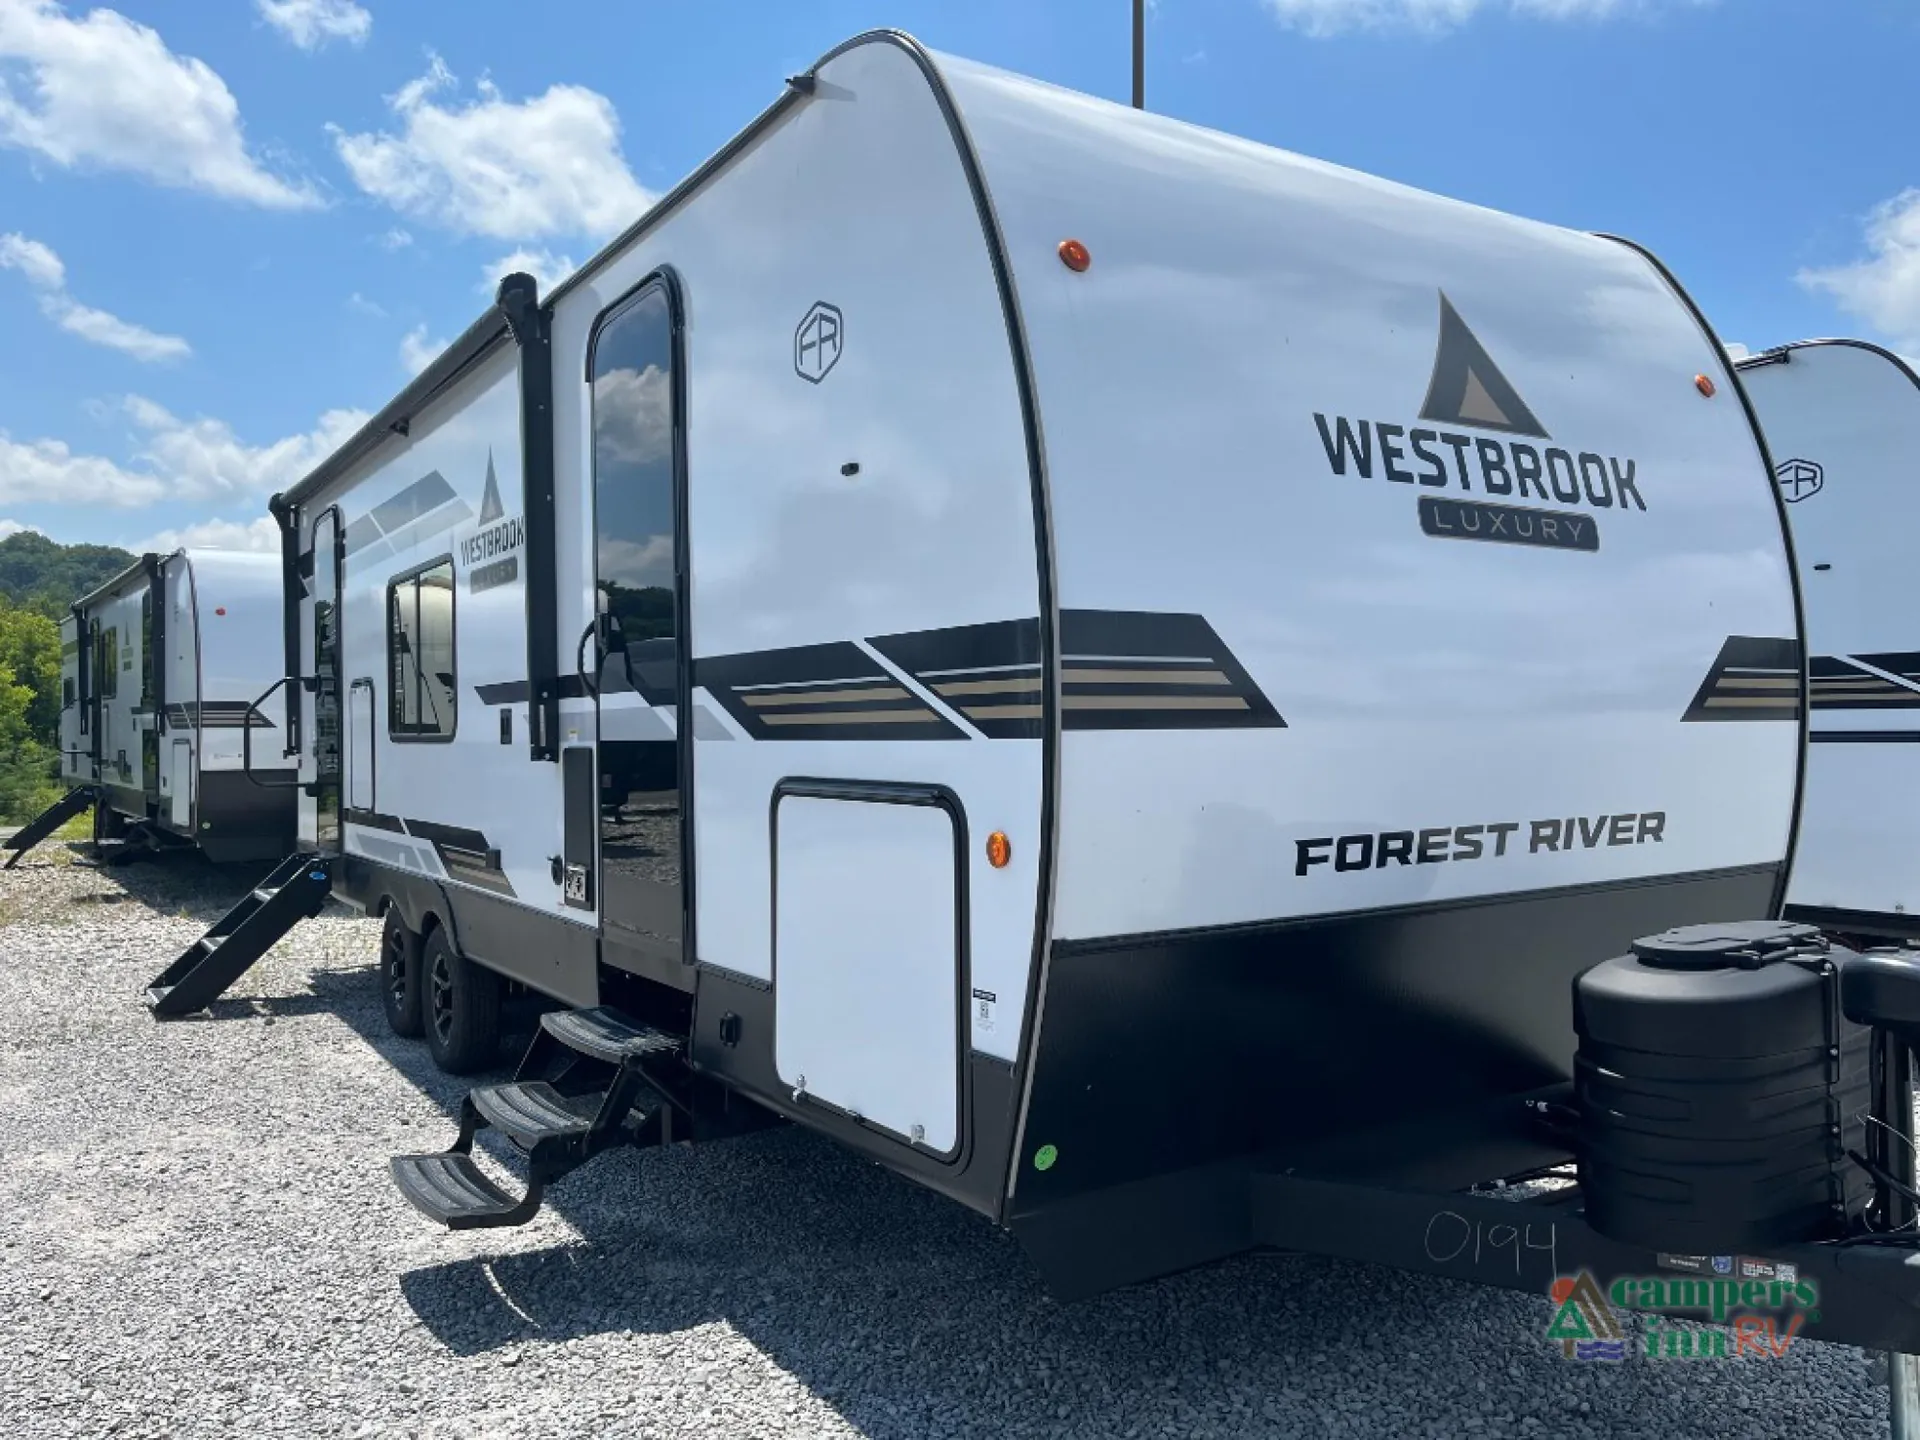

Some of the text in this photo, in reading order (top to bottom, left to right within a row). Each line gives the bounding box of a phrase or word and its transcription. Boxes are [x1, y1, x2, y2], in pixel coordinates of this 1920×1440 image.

[1313, 412, 1647, 512] WESTBROOK
[461, 515, 524, 567] WESTBROOK
[1434, 505, 1582, 542] LUXURY
[1295, 811, 1666, 876] FOREST RIVER
[1425, 1211, 1558, 1295] 0194
